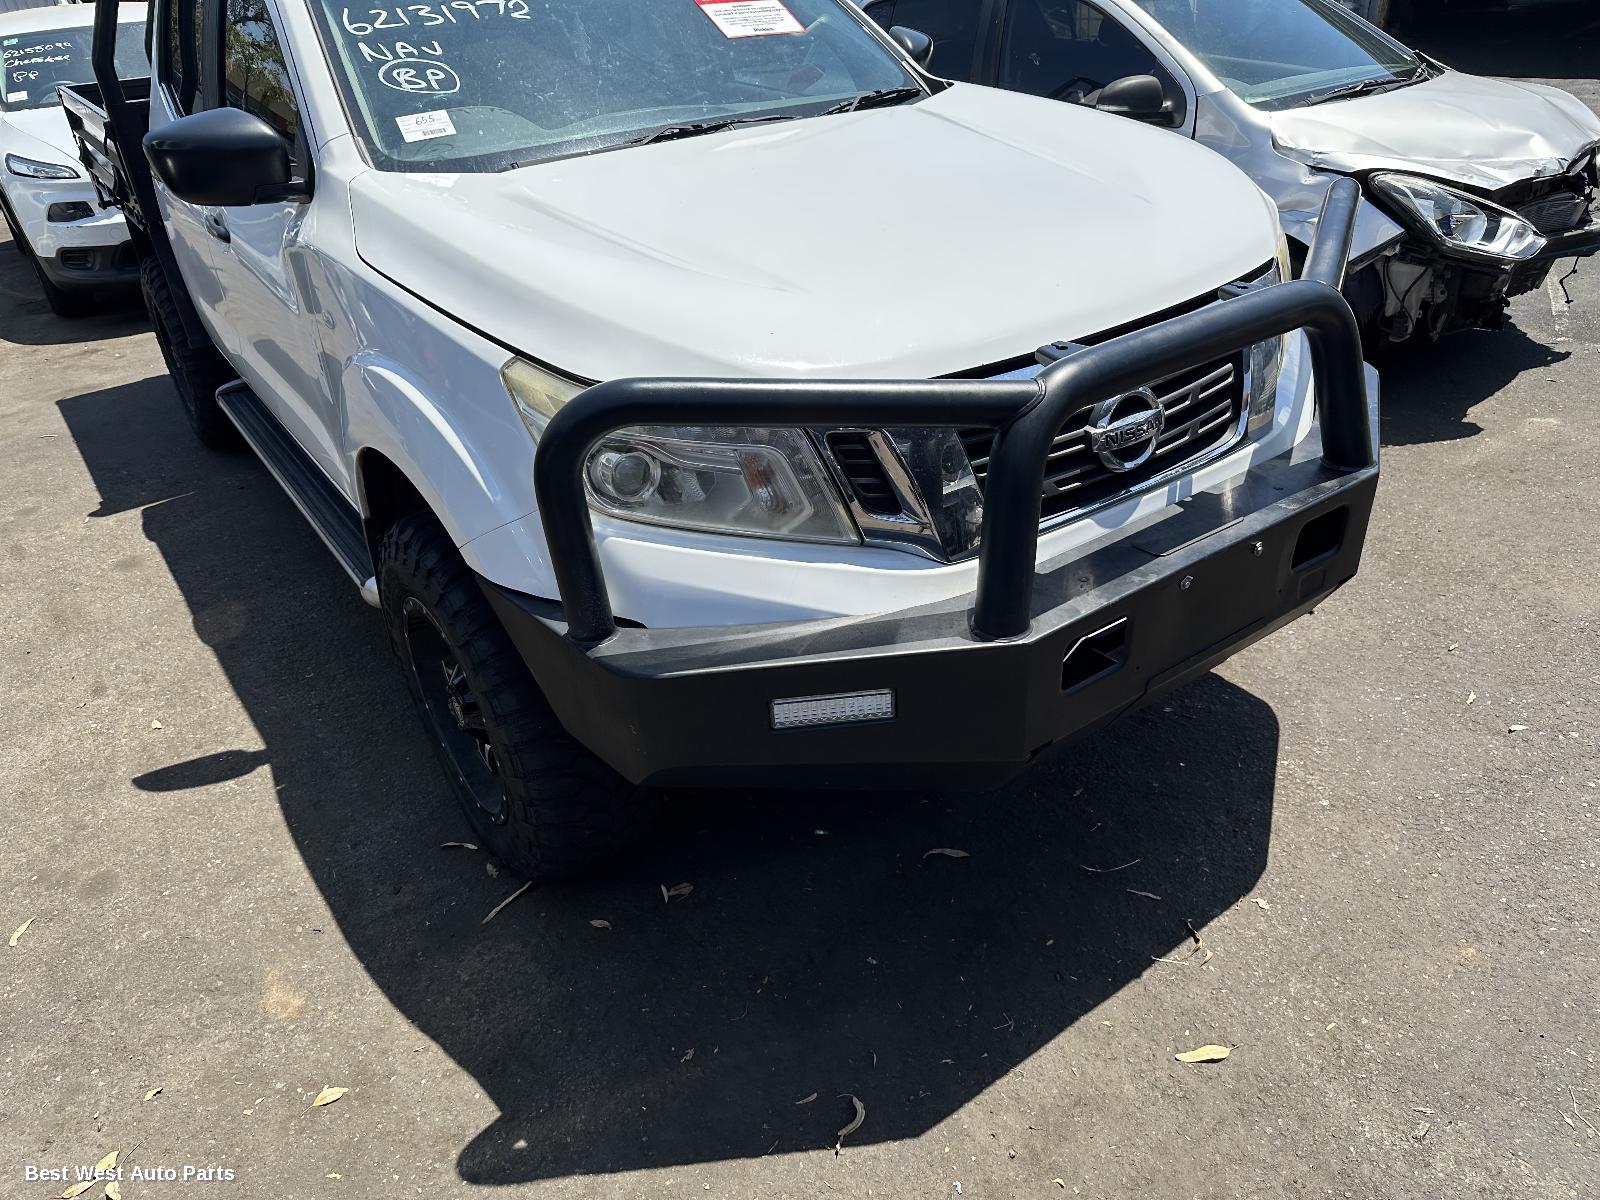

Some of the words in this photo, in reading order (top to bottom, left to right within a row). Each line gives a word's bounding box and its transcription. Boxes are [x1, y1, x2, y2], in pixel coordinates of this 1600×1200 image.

[342, 0, 531, 35] 62131972
[3, 42, 73, 58] 62155099
[357, 41, 443, 62] NAV
[392, 67, 446, 90] BP
[415, 114, 435, 126] 655
[1105, 416, 1161, 446] NISSAN
